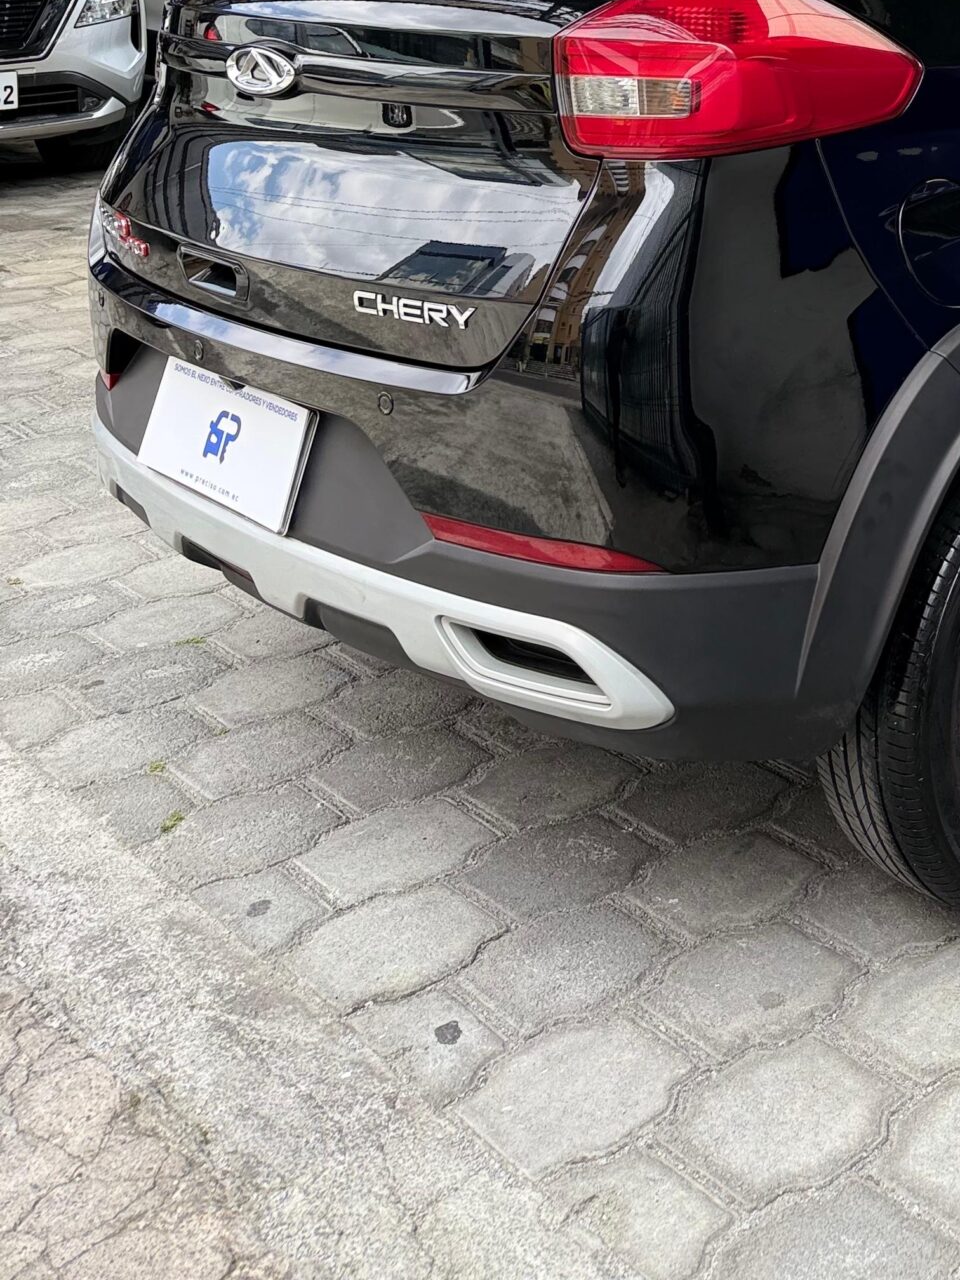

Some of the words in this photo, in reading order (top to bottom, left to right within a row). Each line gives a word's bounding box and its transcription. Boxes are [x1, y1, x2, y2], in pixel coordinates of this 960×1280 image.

[353, 290, 477, 330] CHERY
[174, 363, 191, 377] SOMOS
[197, 371, 211, 384] NEXO
[265, 400, 298, 422] VENDEDORES
